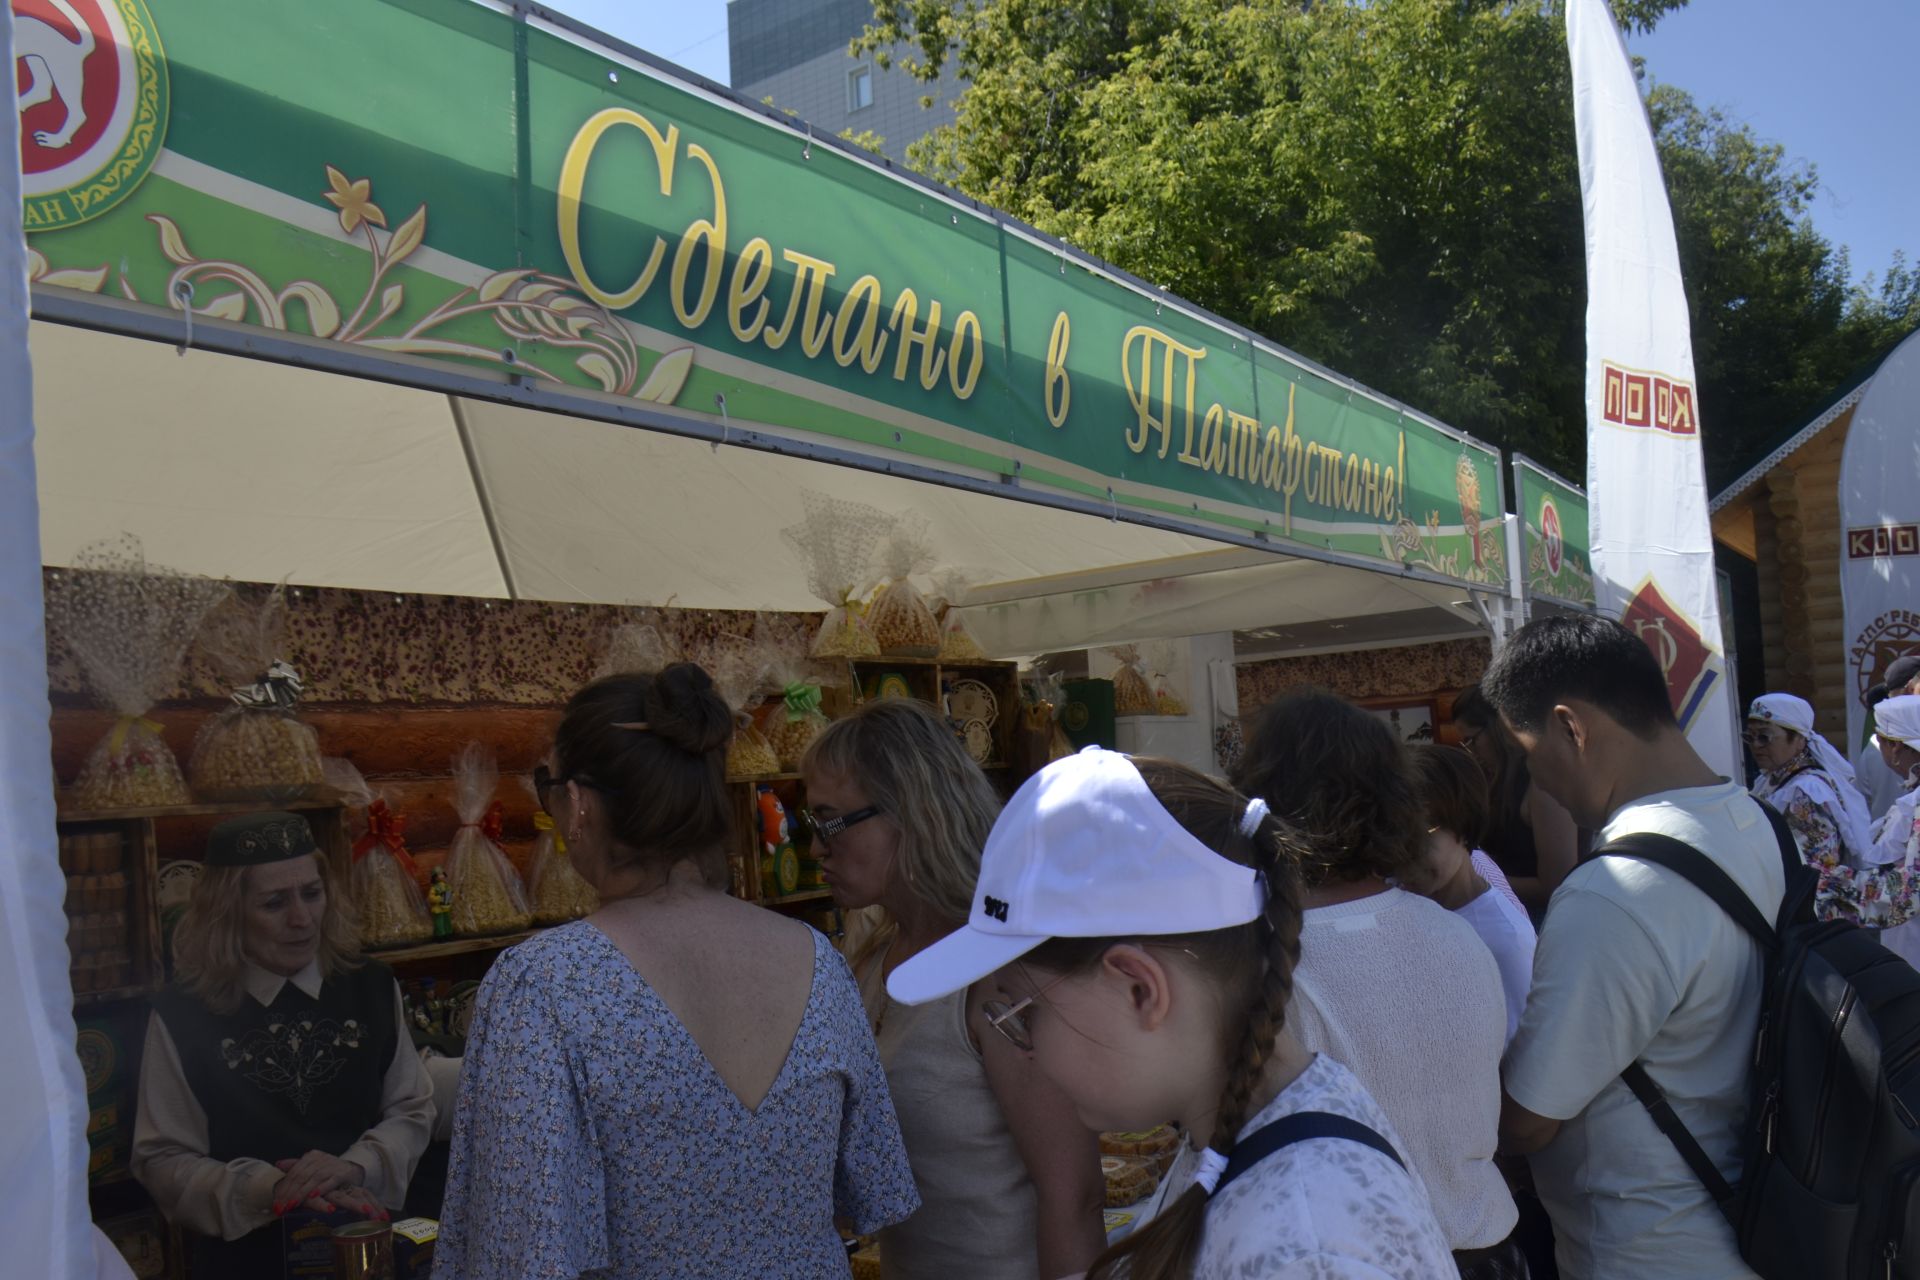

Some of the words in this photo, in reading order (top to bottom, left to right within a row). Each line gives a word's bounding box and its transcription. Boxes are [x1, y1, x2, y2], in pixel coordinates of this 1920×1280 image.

[557, 107, 983, 400] Сделано
[1045, 311, 1070, 428] в
[1122, 326, 1405, 536] Татарстане!
